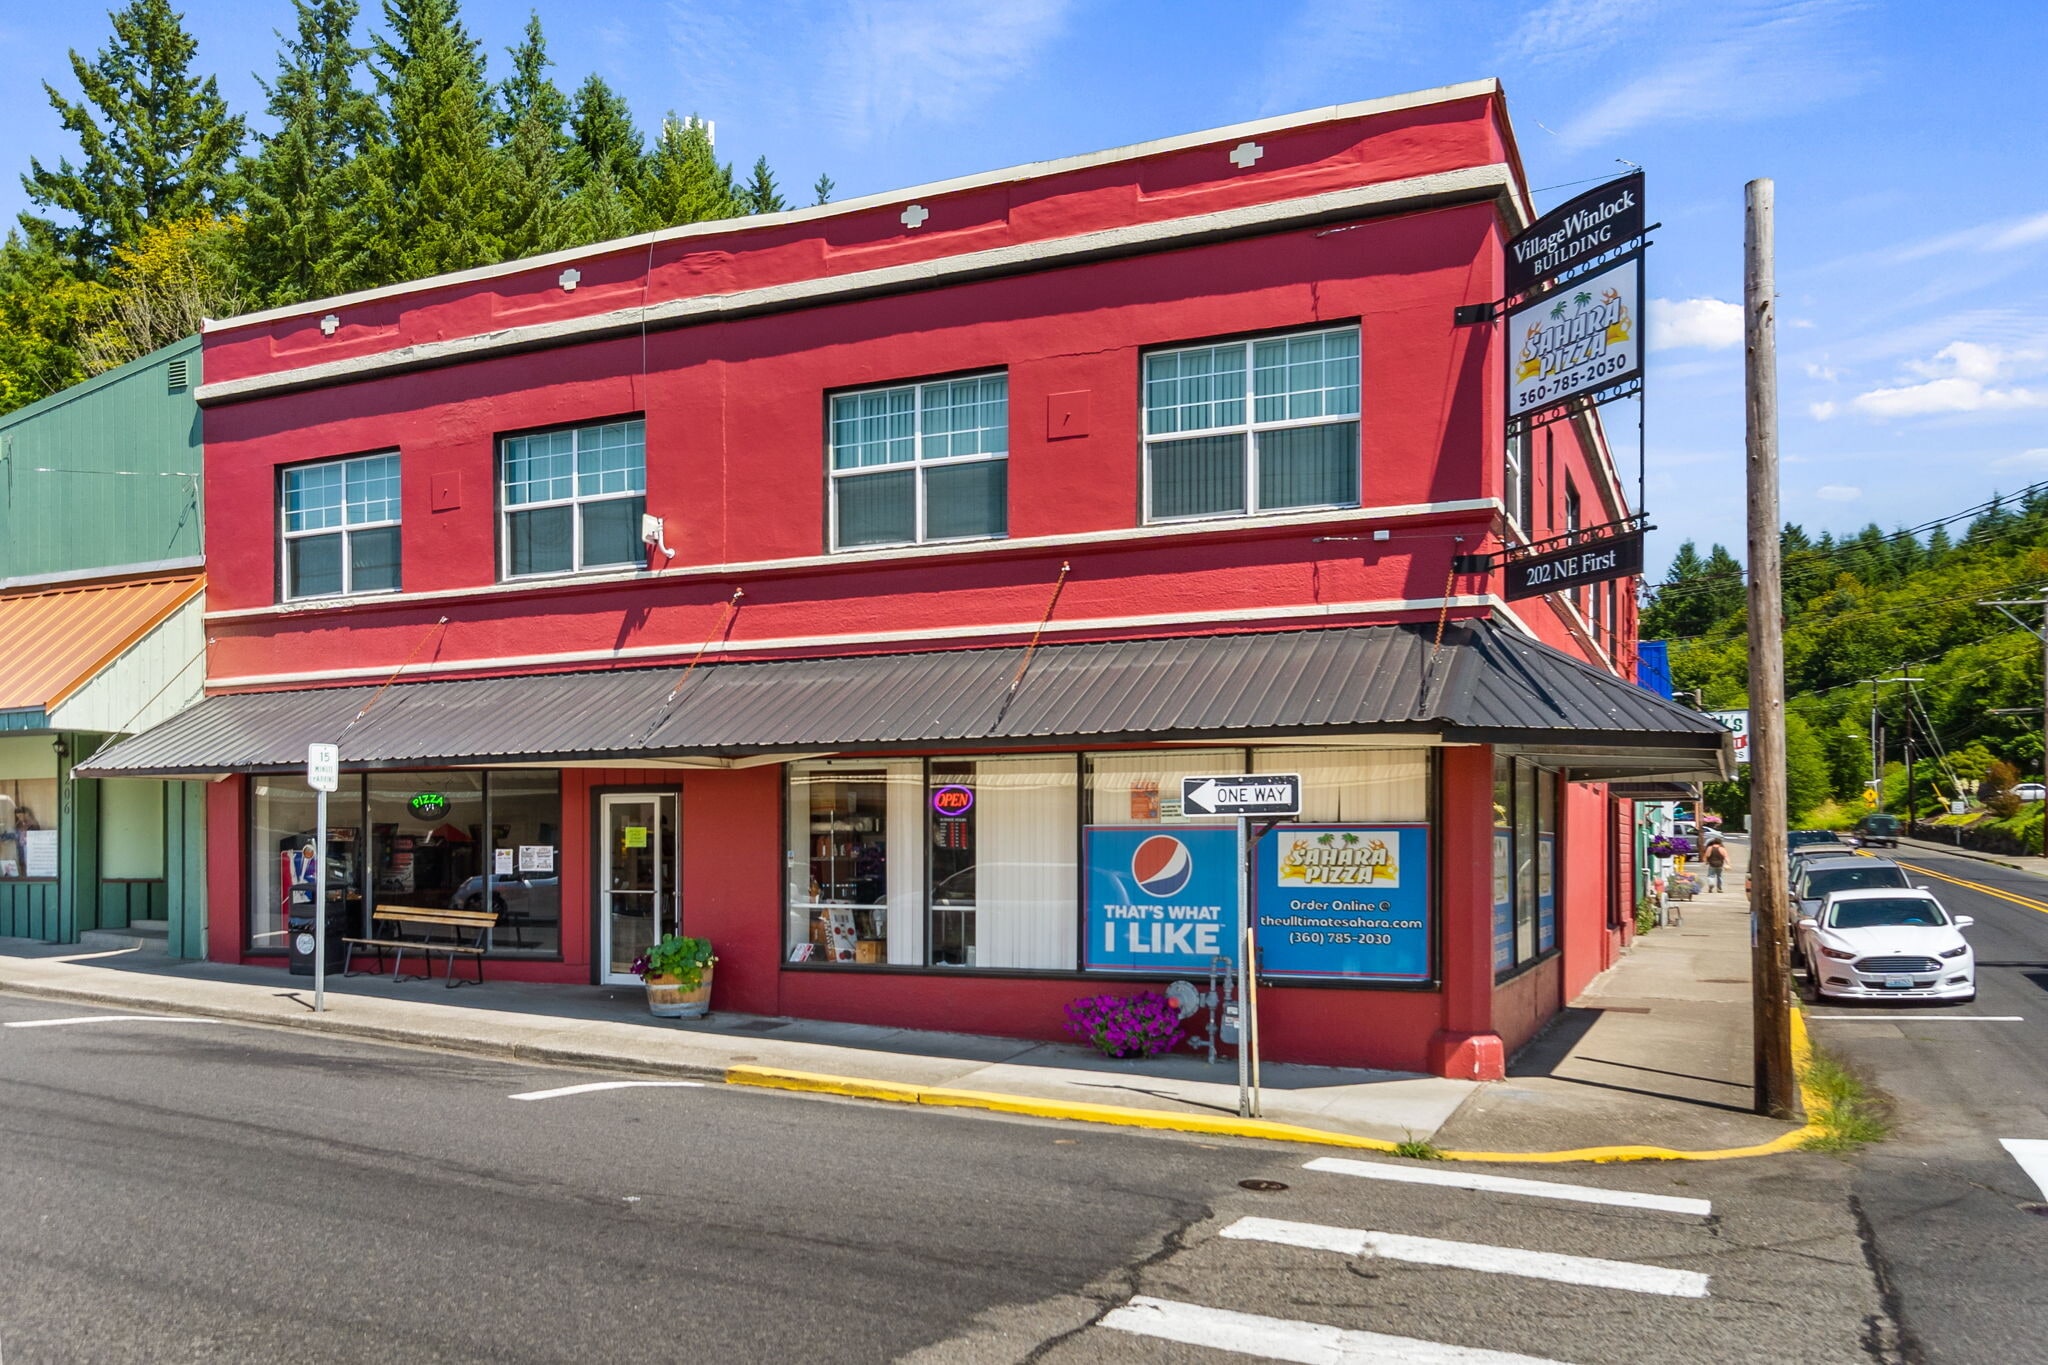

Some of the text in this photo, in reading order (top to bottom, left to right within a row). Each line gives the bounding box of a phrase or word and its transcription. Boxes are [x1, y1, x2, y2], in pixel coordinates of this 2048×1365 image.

[1534, 224, 1612, 275] BUILDING
[1522, 297, 1621, 363] SAHARA
[1538, 330, 1607, 381] PIZZA
[1519, 353, 1627, 407] 360-785-2030
[1526, 550, 1617, 586] 202 NE First
[320, 752, 330, 762] 15
[412, 794, 444, 808] PIZZA
[937, 793, 969, 807] OPEN
[1217, 787, 1287, 803] ONE WAY
[1291, 848, 1388, 866] SAHARA
[1305, 865, 1374, 884] PIZZA
[1104, 904, 1221, 920] THAT'S WHAT
[1290, 900, 1329, 911] Order
[1332, 900, 1376, 911] Online
[1105, 921, 1220, 955] I LIKE
[1289, 932, 1391, 945] (360) 785-2030
